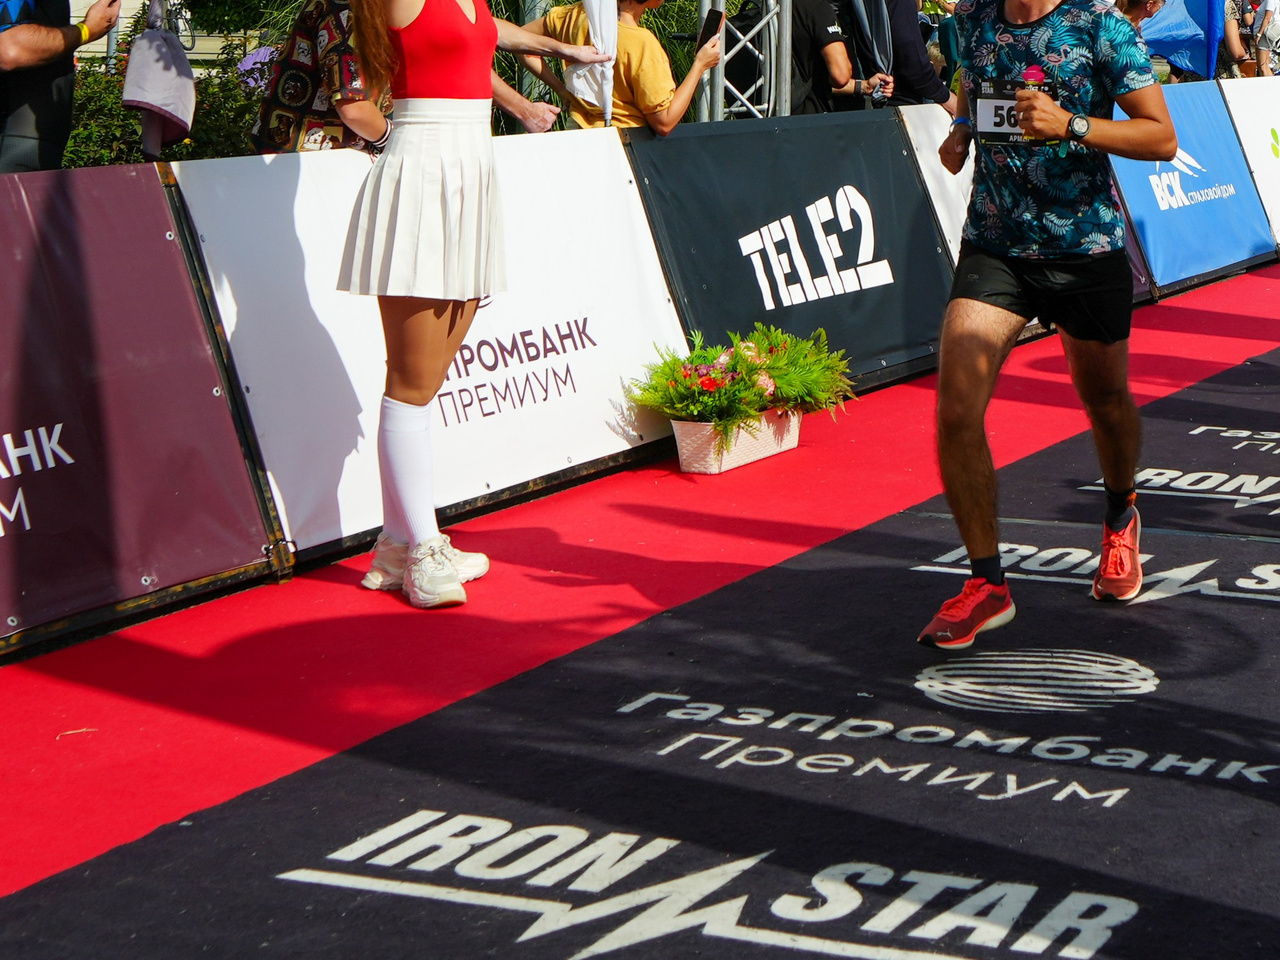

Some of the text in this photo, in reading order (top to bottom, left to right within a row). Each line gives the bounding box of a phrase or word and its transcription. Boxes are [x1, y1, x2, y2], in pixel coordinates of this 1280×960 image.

[1148, 170, 1191, 211] ВСК
[737, 184, 895, 311] TELE2
[445, 316, 598, 382] РОМБАНК
[437, 362, 577, 428] ПРЕМИУМ
[656, 732, 1131, 808] Премиум
[325, 809, 1141, 960] IRON STAR
